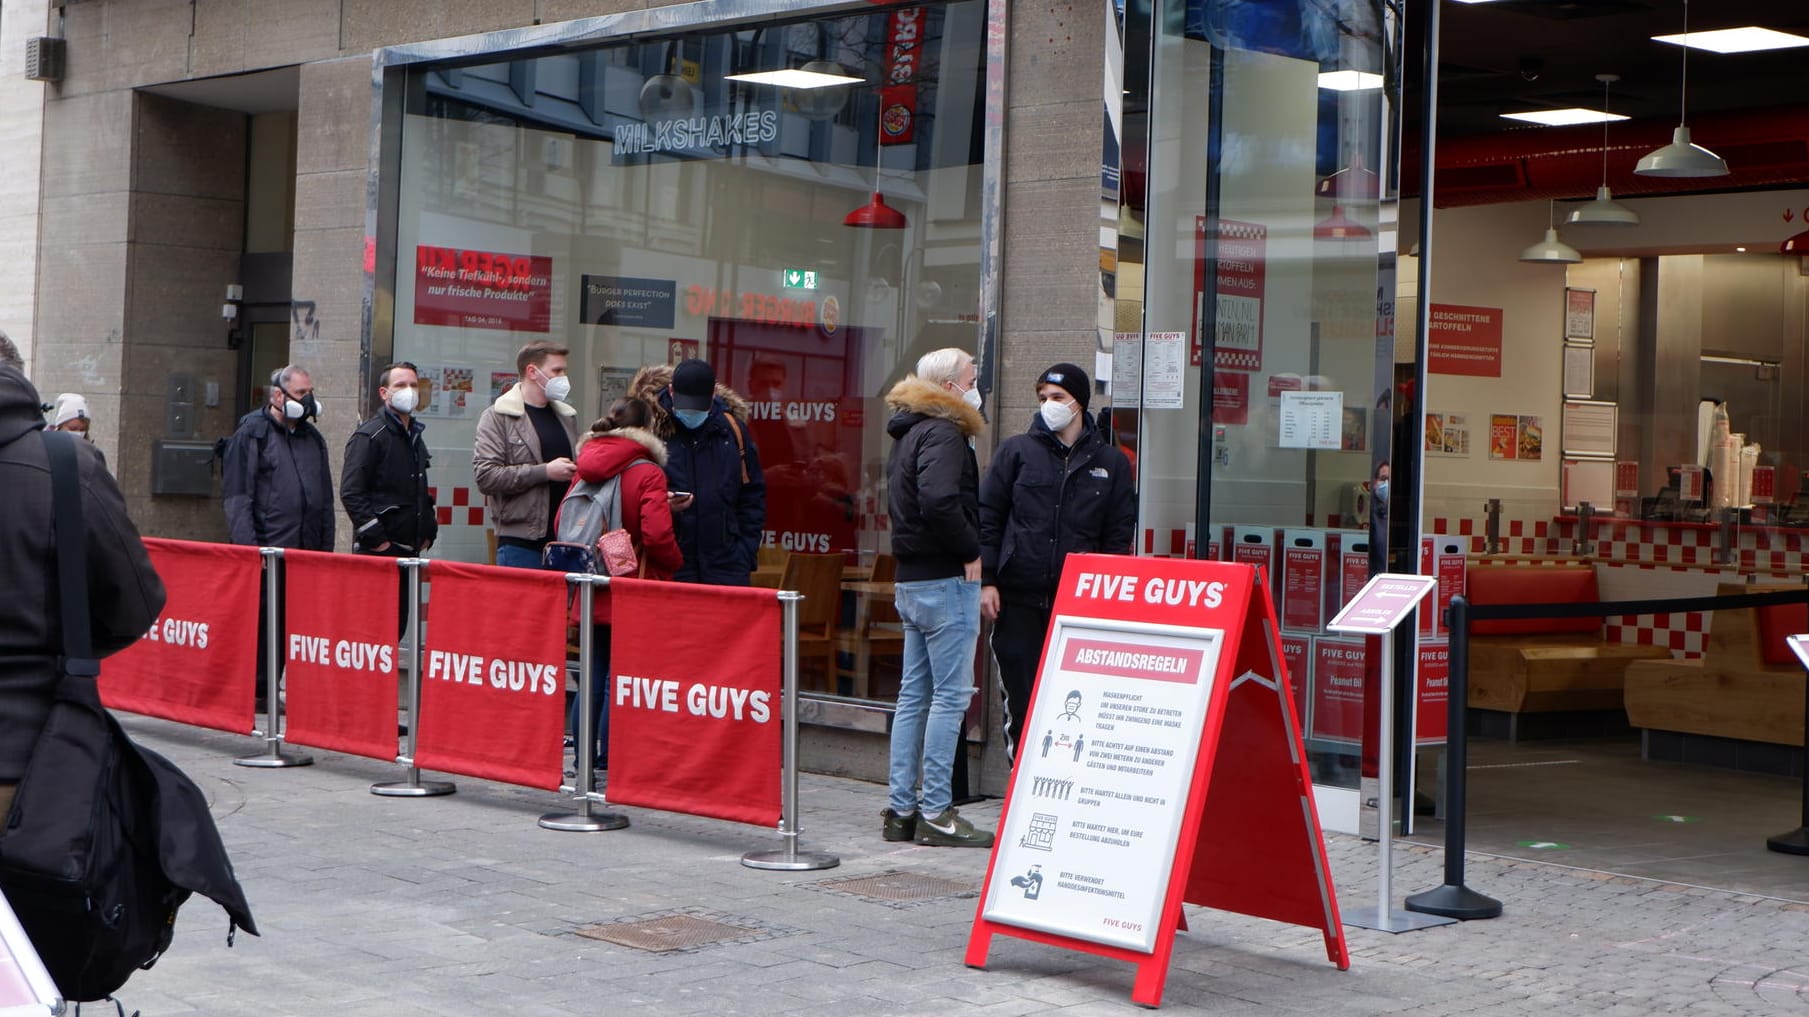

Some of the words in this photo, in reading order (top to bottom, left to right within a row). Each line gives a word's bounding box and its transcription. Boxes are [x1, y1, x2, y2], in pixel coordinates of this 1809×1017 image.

[614, 110, 777, 155] MILKSHAKES
[1218, 245, 1257, 258] HEUTIGEN
[508, 274, 548, 288] sondern
[428, 284, 446, 296] nur
[448, 285, 480, 299] frische
[623, 288, 671, 300] PERFECTION
[606, 300, 626, 311] DOES
[1433, 311, 1492, 324] GESCHNITTENE
[1149, 333, 1163, 341] FIVE
[1163, 333, 1180, 341] GUYS
[786, 402, 836, 422] GUYS
[1493, 425, 1516, 439] BEST
[781, 531, 831, 553] GUYS
[1251, 549, 1268, 557] GUYS
[1302, 553, 1319, 561] GUYS
[1075, 573, 1138, 602] FIVE
[1144, 577, 1224, 608] GUYS
[164, 618, 209, 649] GUYS
[290, 634, 331, 665] FIVE
[335, 640, 393, 674] GUYS
[1322, 648, 1343, 657] FIVE
[1421, 651, 1437, 661] FIVE
[1076, 647, 1187, 673] ABSTANDSREGELN
[429, 650, 483, 685] FIVE
[490, 659, 556, 695] GUYS
[1330, 675, 1353, 687] Peanut
[617, 675, 679, 712] FIVE
[688, 683, 770, 723] GUYS
[1103, 691, 1143, 702] MASKENPFLICHT
[1100, 702, 1109, 710] UM
[1110, 703, 1132, 712] UNSEREN
[1133, 705, 1148, 714] STORE
[1157, 709, 1182, 718] BETRETEN
[1096, 722, 1115, 732] TRAGEN
[1125, 715, 1151, 726] ZWINGEND
[1152, 719, 1164, 727] EINE
[1164, 720, 1182, 729] MASKE
[1059, 733, 1070, 743] 2m
[1092, 739, 1105, 748] BITTE
[1106, 741, 1124, 751] ACHTET
[1124, 744, 1135, 752] AUF
[1135, 746, 1151, 755] EINEN
[1151, 748, 1175, 758] ABSTAND
[1089, 750, 1100, 758] VON
[1100, 751, 1113, 760] ZWEI
[1113, 753, 1133, 763] METERN
[1134, 757, 1142, 765] ZU
[1142, 757, 1166, 767] ANDEREN
[1106, 763, 1118, 771] UND
[1118, 765, 1154, 776] MITARBEITERN
[1078, 797, 1101, 808] GRUPPEN
[1080, 787, 1094, 797] BITTE
[1094, 789, 1115, 800] WARTET
[1115, 792, 1132, 801] ALLEIN
[1132, 795, 1144, 803] UND
[1144, 796, 1160, 805] NICHT
[1160, 798, 1166, 806] IN
[1072, 821, 1086, 830] BITTE
[1086, 823, 1107, 833] WARTET
[1121, 828, 1130, 836] UM
[1130, 829, 1143, 838] EURE
[1069, 831, 1101, 843] BESTELLUNG
[1101, 836, 1131, 848] ABZUHOLEN
[1059, 871, 1074, 881] BITTE
[1074, 874, 1105, 886] VERWENDET
[1057, 881, 1126, 900] HANDDESINFEKTIONSMITTEL
[1103, 918, 1120, 929] FIVE
[1121, 921, 1143, 931] GUYS
